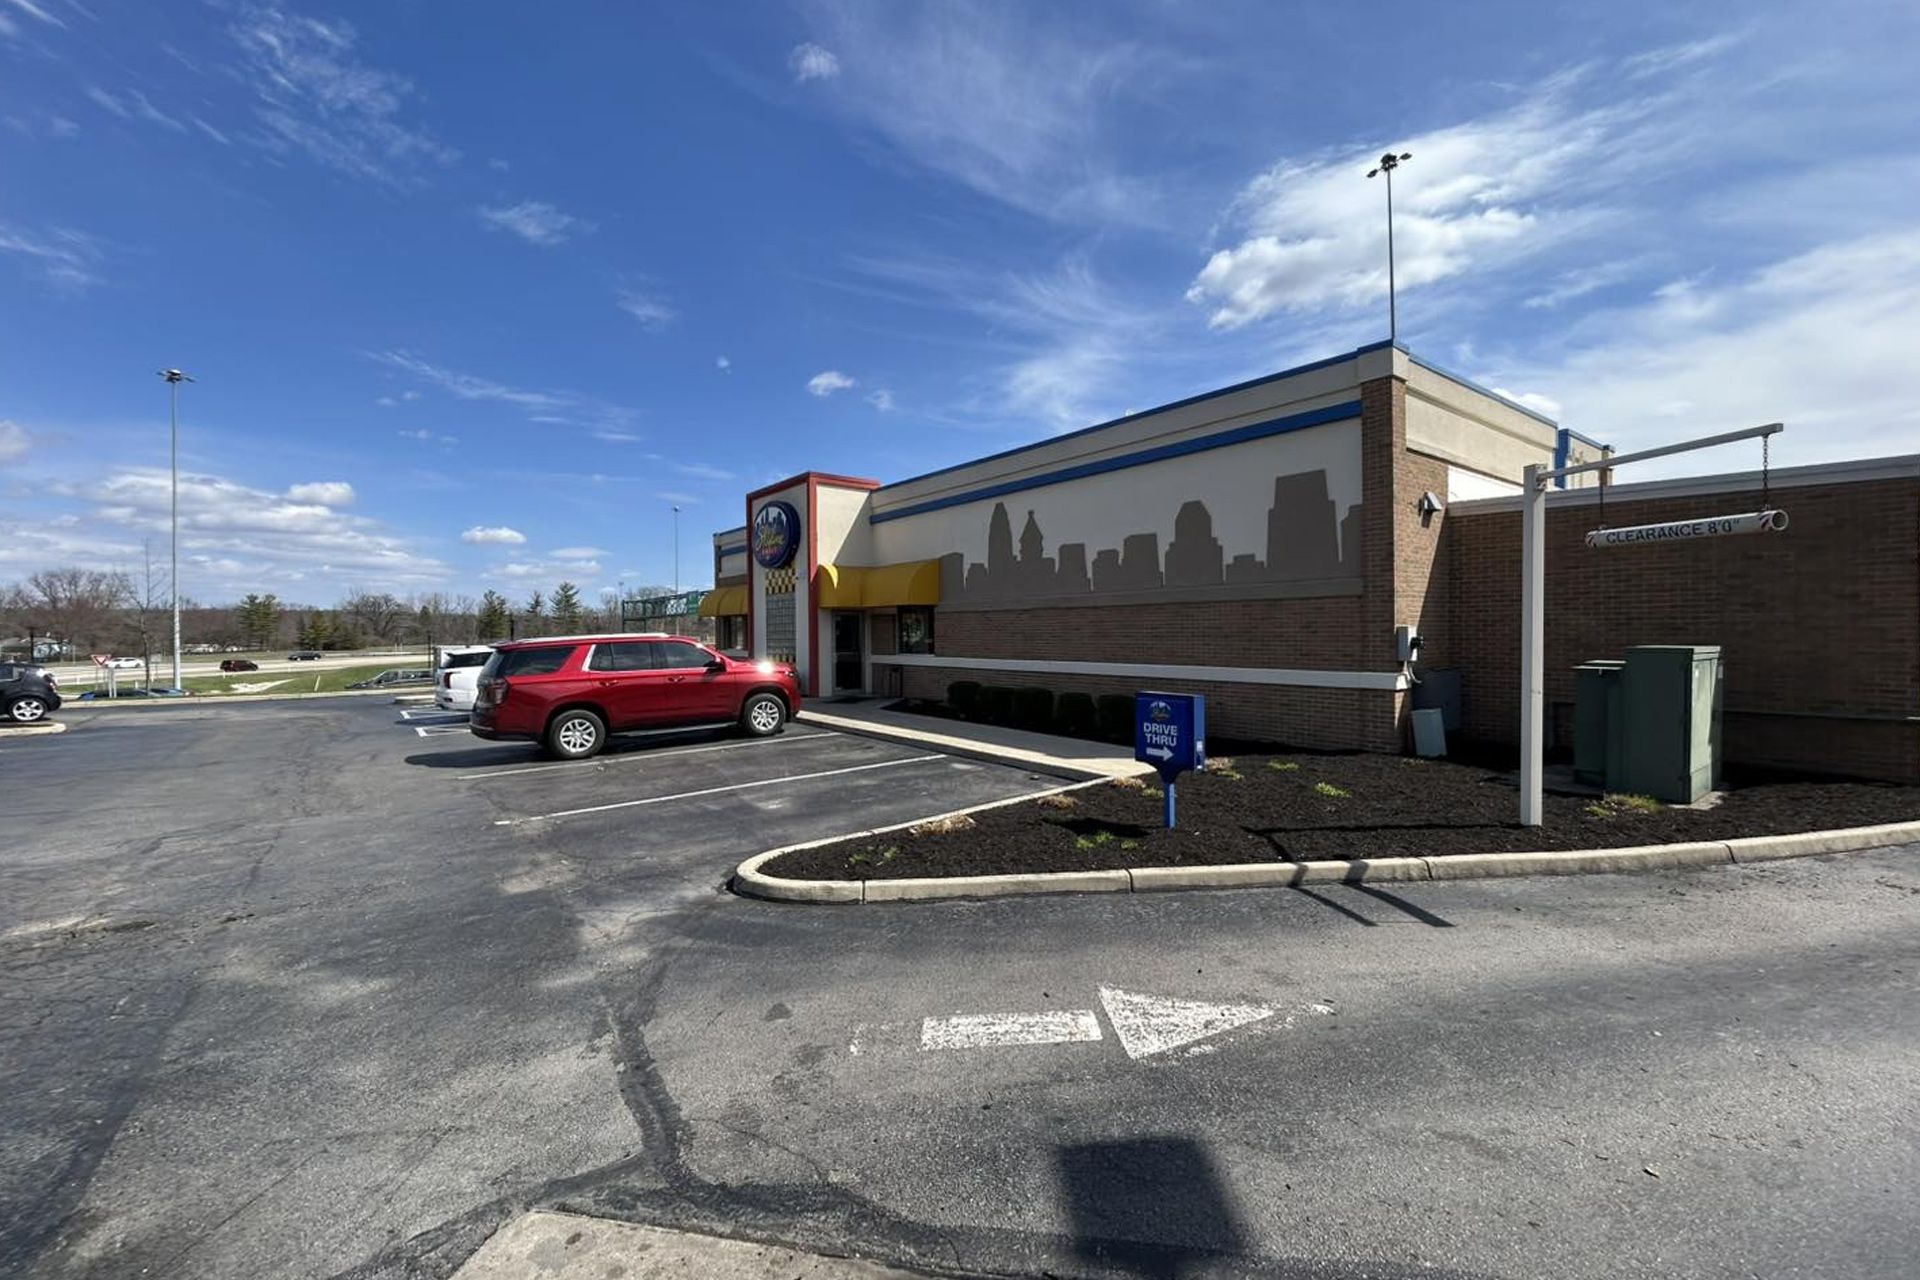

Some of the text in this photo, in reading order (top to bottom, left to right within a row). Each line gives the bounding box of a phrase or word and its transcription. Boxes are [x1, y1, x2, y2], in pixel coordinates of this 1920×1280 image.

[1606, 524, 1704, 545] CLEARANCE
[1143, 722, 1178, 736] DRIVE
[1145, 733, 1177, 747] THRU
